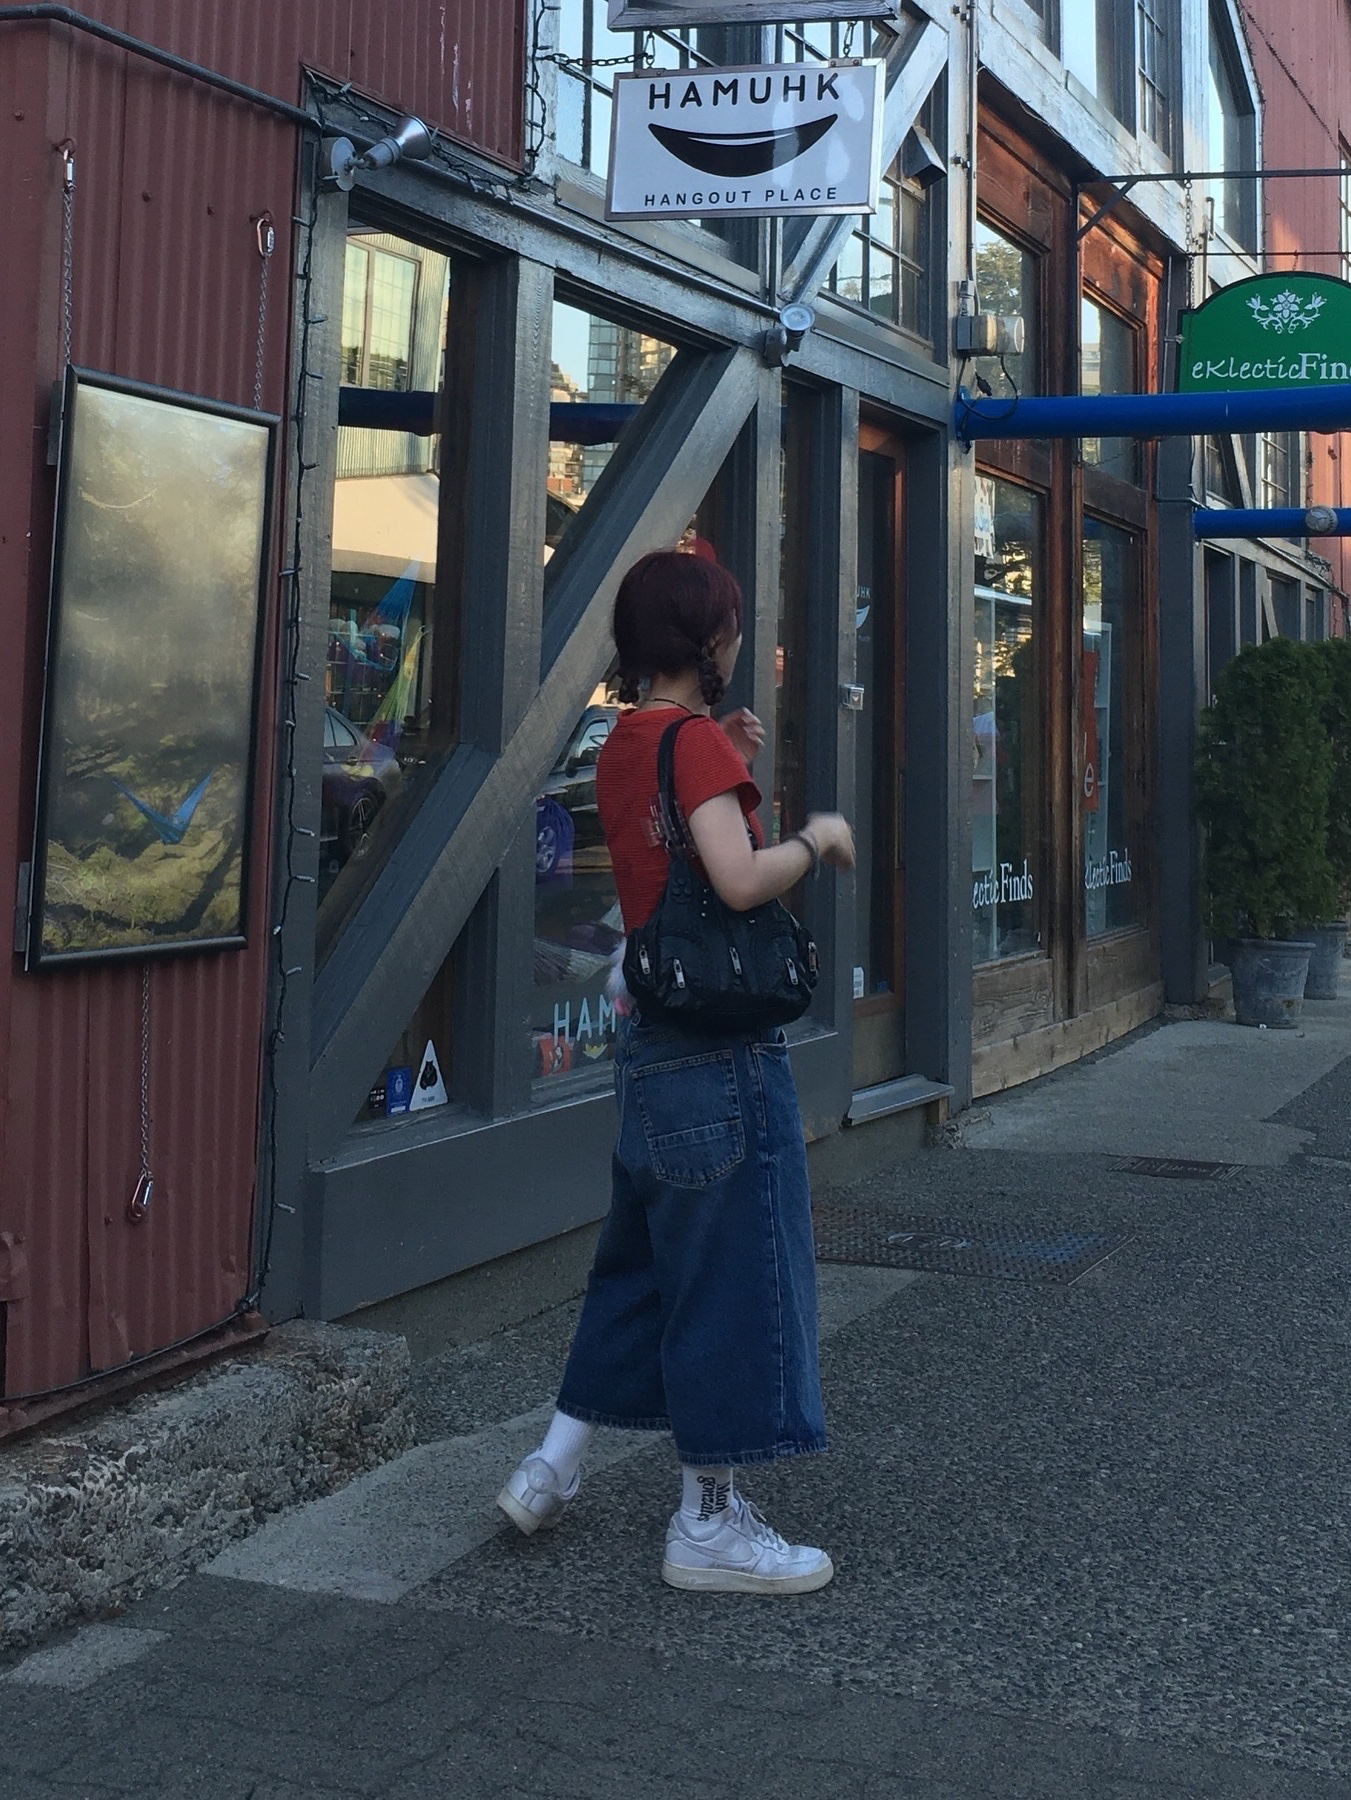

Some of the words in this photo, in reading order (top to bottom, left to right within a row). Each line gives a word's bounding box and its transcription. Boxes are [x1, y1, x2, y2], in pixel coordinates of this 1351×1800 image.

[649, 73, 839, 110] HAMUHK
[644, 190, 751, 207] HANGOUT
[765, 187, 837, 202] PLACE
[554, 994, 616, 1047] HAM
